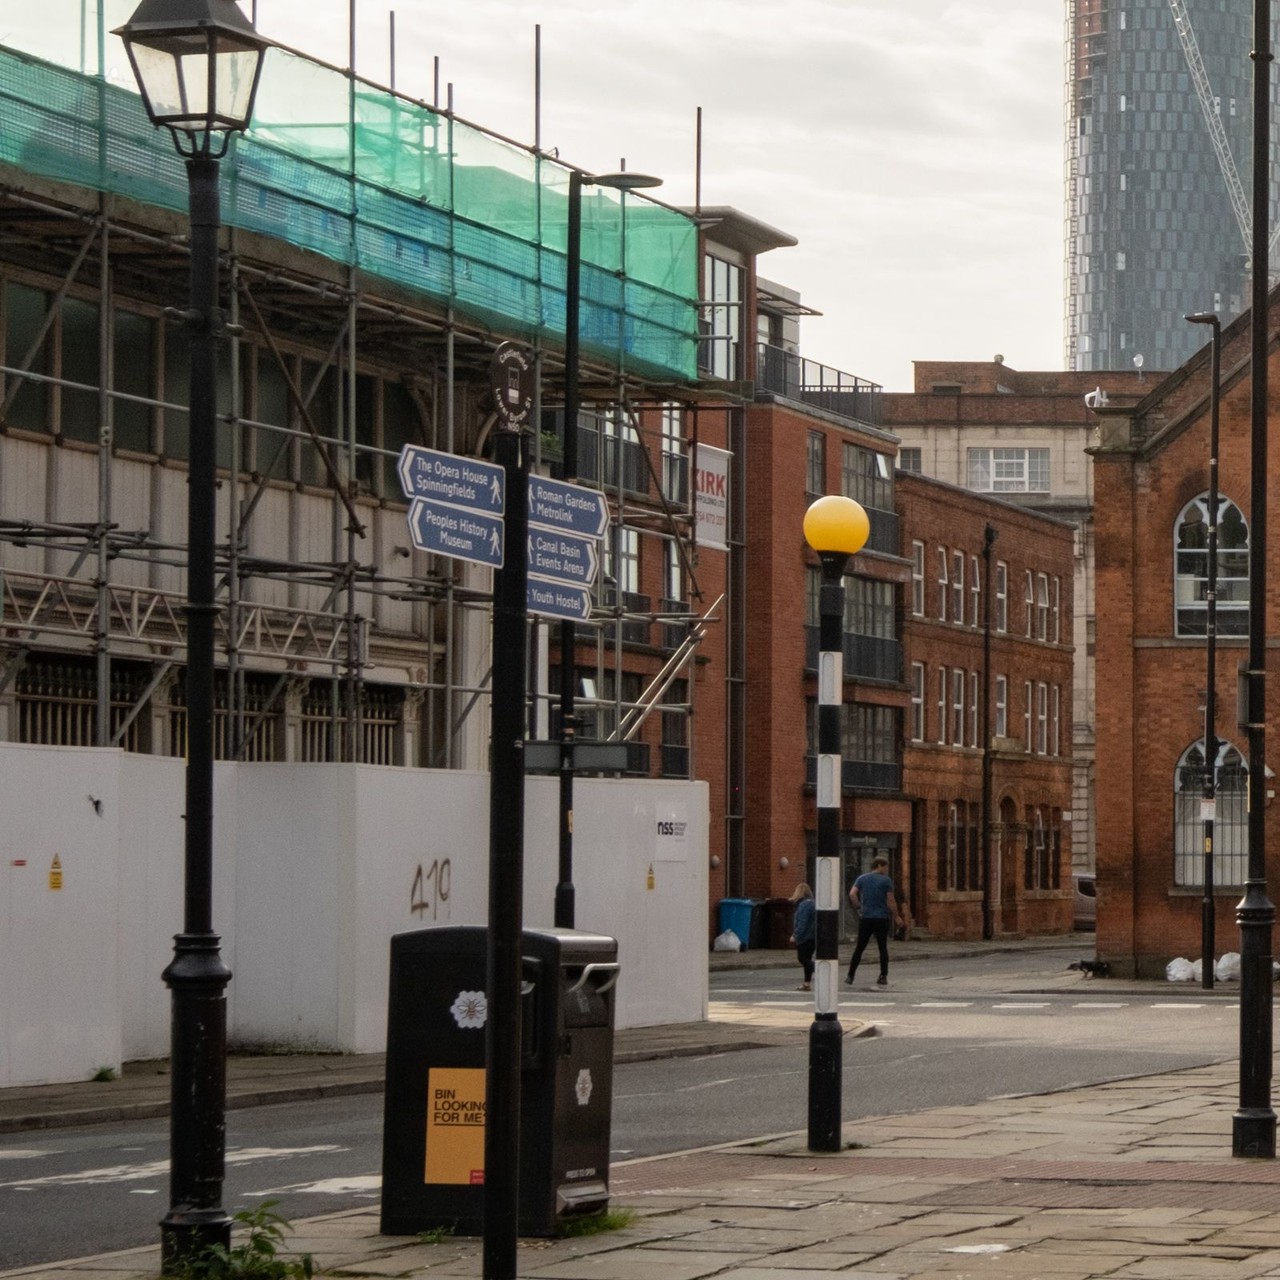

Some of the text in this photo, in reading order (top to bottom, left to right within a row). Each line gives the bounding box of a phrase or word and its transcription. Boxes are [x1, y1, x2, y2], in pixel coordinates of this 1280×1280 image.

[416, 458, 488, 485] The Opera House
[416, 477, 476, 500] Spinningfields
[537, 486, 596, 512] Roman Gardens
[536, 504, 573, 523] Metrolink
[426, 510, 488, 542] Peoples History
[440, 531, 473, 551] Museum
[536, 537, 581, 558] Canal Basin
[536, 555, 585, 576] Events Arena
[532, 588, 581, 610] Youth Hostel
[657, 821, 674, 835] nss
[434, 1089, 456, 1100] BIN
[433, 1112, 460, 1123] FOR
